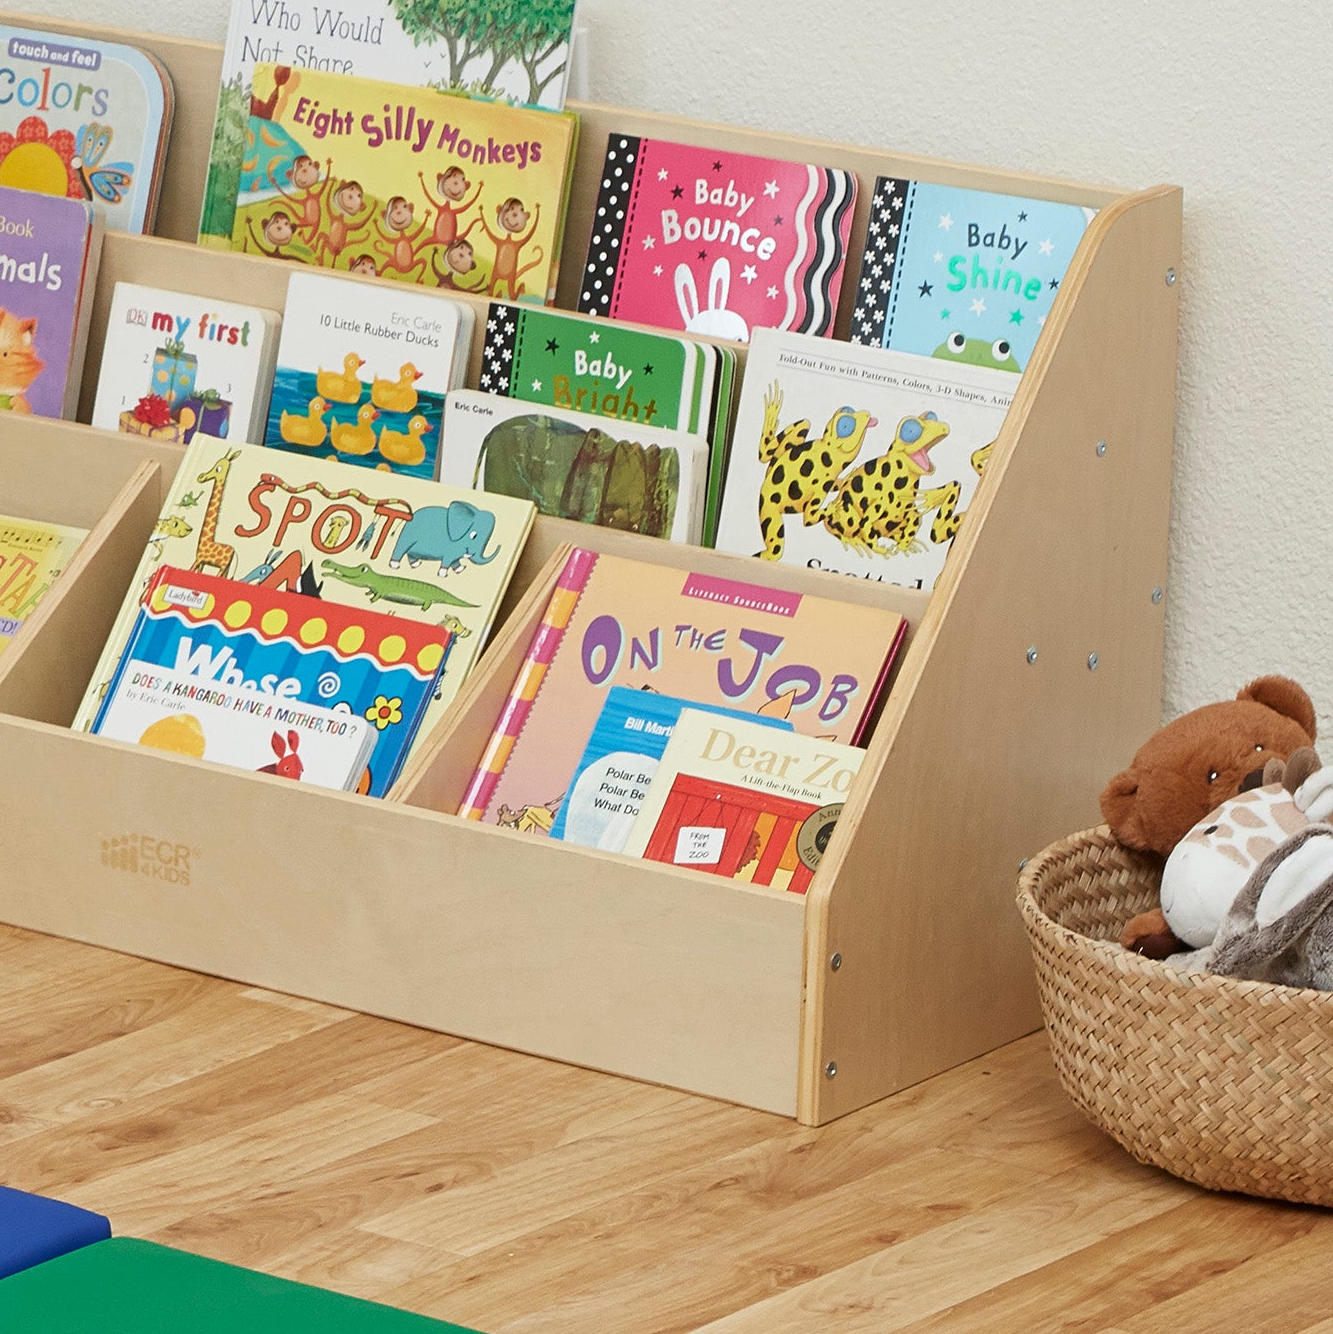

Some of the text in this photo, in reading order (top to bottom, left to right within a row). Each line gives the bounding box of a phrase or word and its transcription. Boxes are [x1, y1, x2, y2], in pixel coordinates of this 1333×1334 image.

[313, 7, 384, 45] Would
[13, 41, 97, 66] touch and feel
[241, 36, 283, 62] Not
[293, 97, 542, 169] Eight Silly Monkeys
[695, 178, 755, 217] Baby
[661, 209, 777, 261] Bounce
[967, 223, 1028, 260] Baby
[946, 254, 1042, 301] Shine
[126, 309, 148, 326] DK
[151, 312, 250, 347] my first
[319, 314, 439, 348] 10 Little Rubber Ducks
[390, 312, 443, 333] Eric Carle
[142, 353, 149, 363] 2
[574, 350, 633, 390] Baby
[779, 354, 817, 368] Fold-Out
[819, 362, 837, 371] Fun
[839, 366, 858, 377] with
[861, 370, 899, 385] Patterns,
[902, 378, 932, 392] Colors,
[954, 389, 987, 403] Shapes,
[454, 401, 494, 416] Eric Carle
[553, 374, 658, 425] Bright
[234, 480, 413, 560] SPOT
[168, 589, 204, 605] Ladybird
[582, 615, 859, 722] ON THE JOB
[125, 689, 186, 711] by Eric Carle
[132, 672, 162, 691] DOES
[163, 681, 172, 693] A
[172, 683, 233, 709] KANGAROO
[233, 698, 264, 716] HAVE
[263, 705, 273, 718] A
[274, 707, 324, 733] MOTHER,
[624, 716, 675, 737] Bill Marti
[699, 727, 857, 793] Dear Zo
[605, 767, 652, 785] Polar Be
[741, 775, 748, 783] A
[801, 789, 822, 800] Book
[599, 782, 645, 801] Polar Be
[594, 798, 640, 816] What Do
[690, 832, 710, 840] FROM
[689, 851, 710, 859] ZOO
